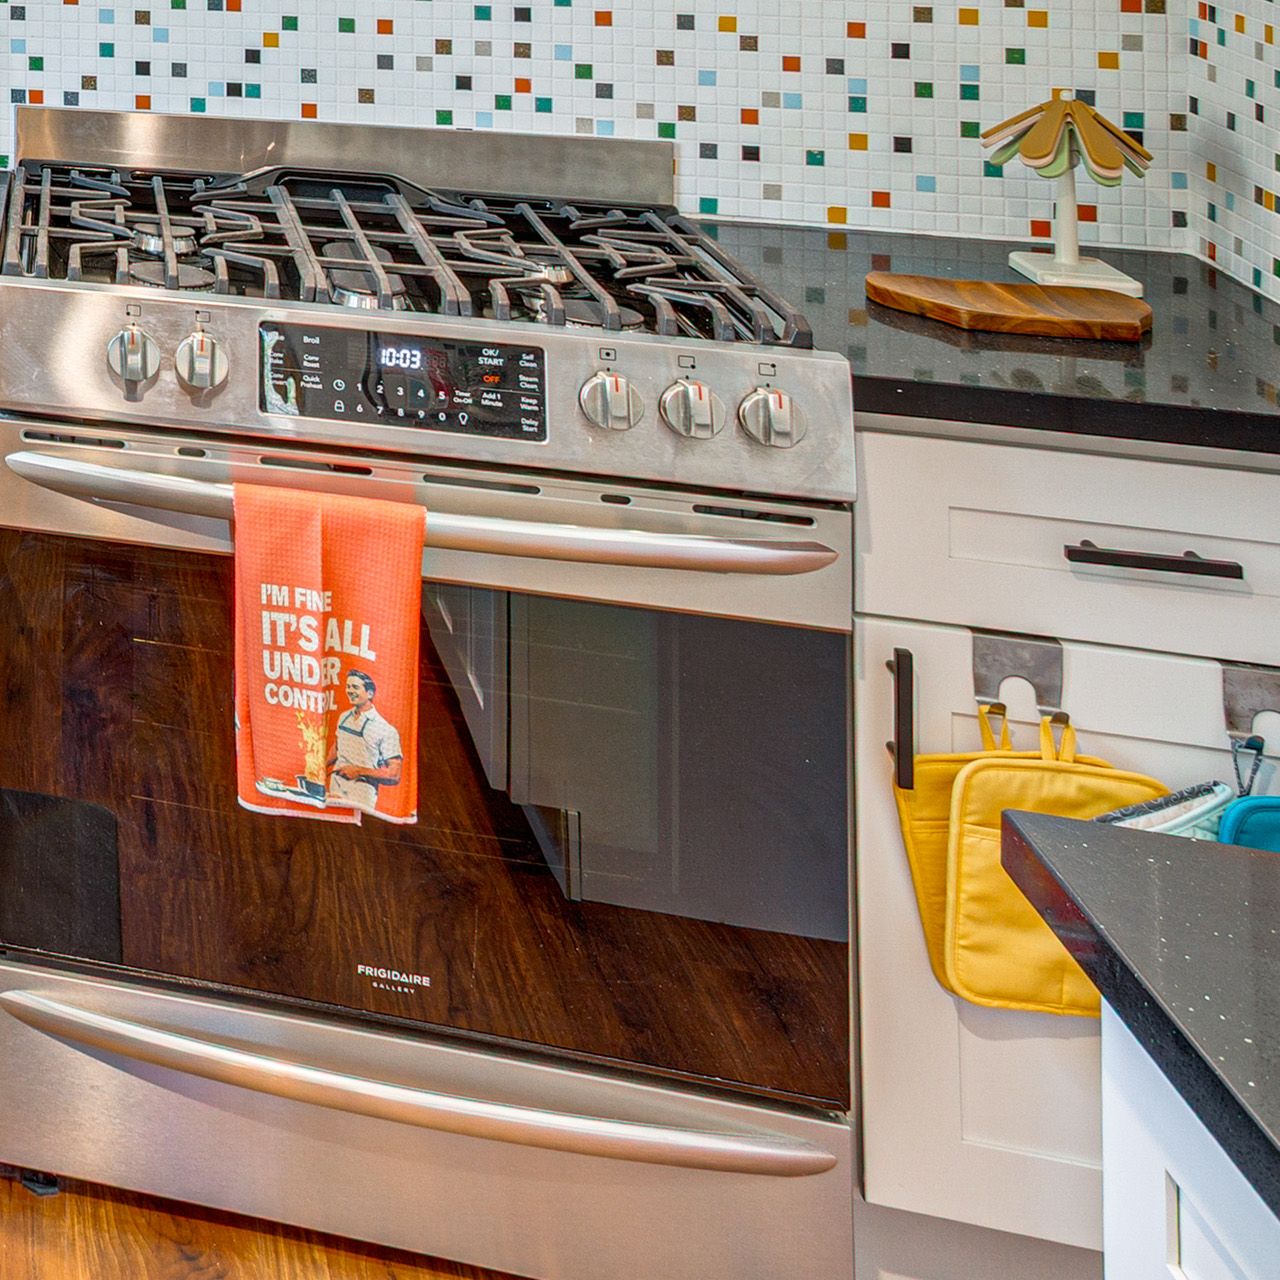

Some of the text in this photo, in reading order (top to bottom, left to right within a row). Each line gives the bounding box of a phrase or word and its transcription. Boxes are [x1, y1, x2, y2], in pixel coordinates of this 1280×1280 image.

[303, 336, 320, 345] Broil
[380, 348, 422, 369] 10:03
[478, 357, 504, 367] START
[483, 375, 501, 384] OFF
[357, 383, 446, 400] 1 2 3 4 5
[481, 399, 503, 407] Minute
[356, 404, 446, 421] 6 7 8 9 0
[261, 583, 333, 612] I'M FINE
[262, 610, 377, 661] IT'S ALL
[263, 649, 342, 688] UNDER
[264, 682, 338, 714] CONTRL
[357, 964, 431, 987] FRIGIDAIRE
[372, 981, 415, 994] GALLERY
